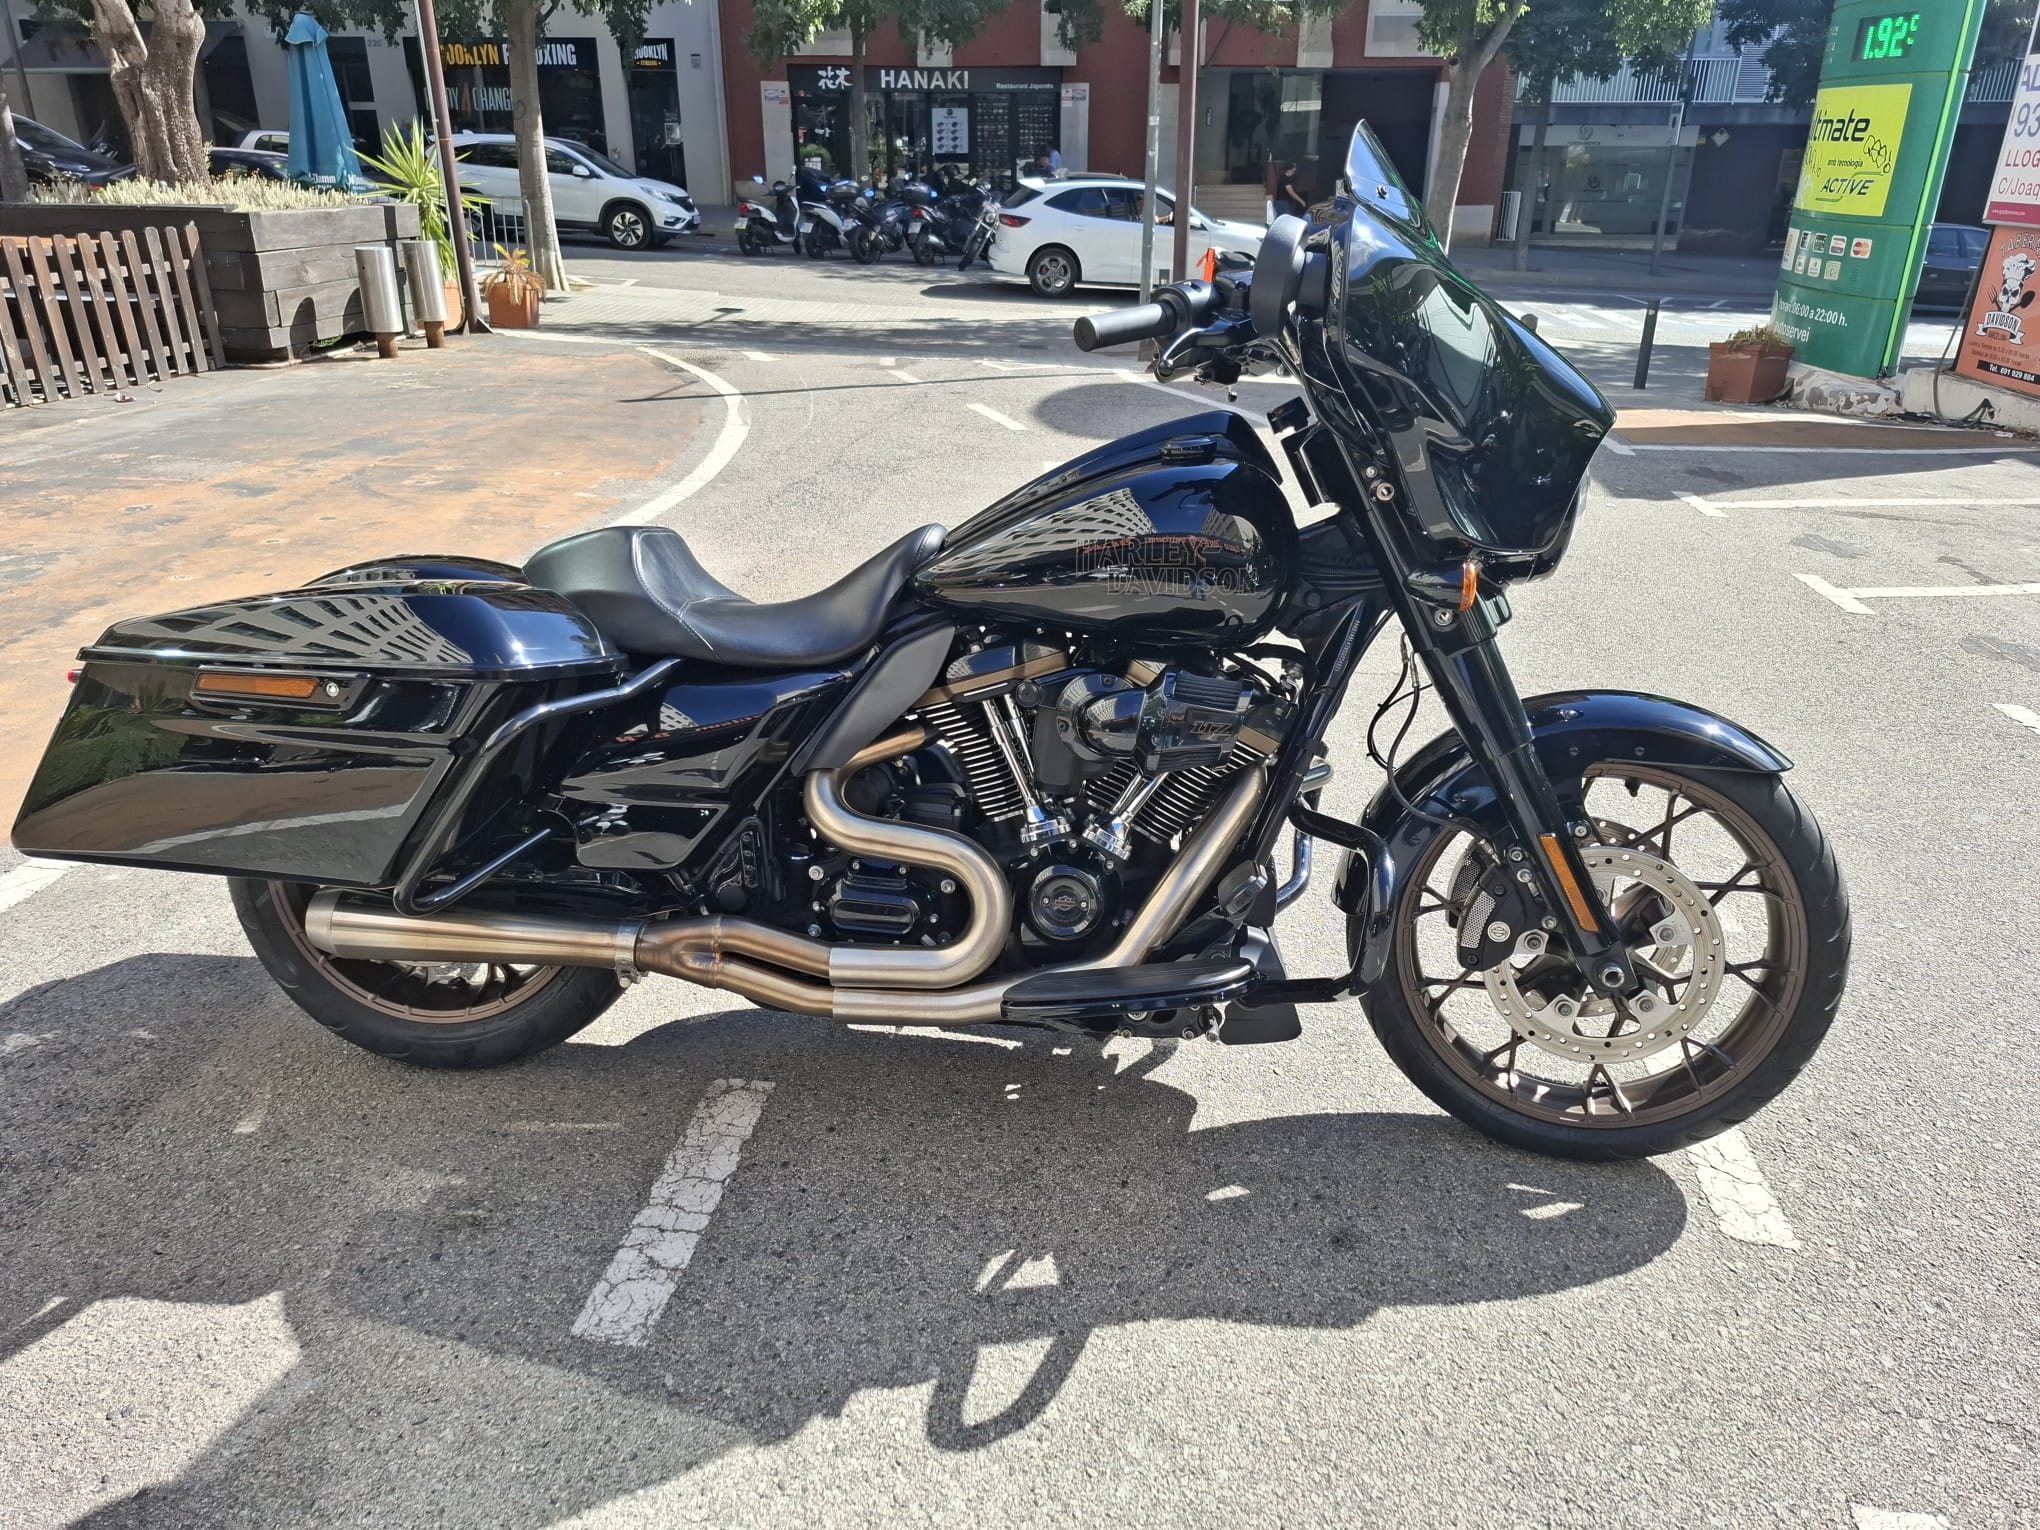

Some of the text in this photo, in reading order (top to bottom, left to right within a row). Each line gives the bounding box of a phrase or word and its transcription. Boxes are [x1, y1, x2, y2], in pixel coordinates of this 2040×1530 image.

[881, 70, 969, 89] HANAKI
[1820, 177, 1875, 196] ACTIVE
[1809, 309, 1815, 319] a
[1814, 308, 1839, 325] 22:00
[1986, 313, 2020, 332] DAVIDSON
[1107, 567, 1258, 597] DAVIDSON
